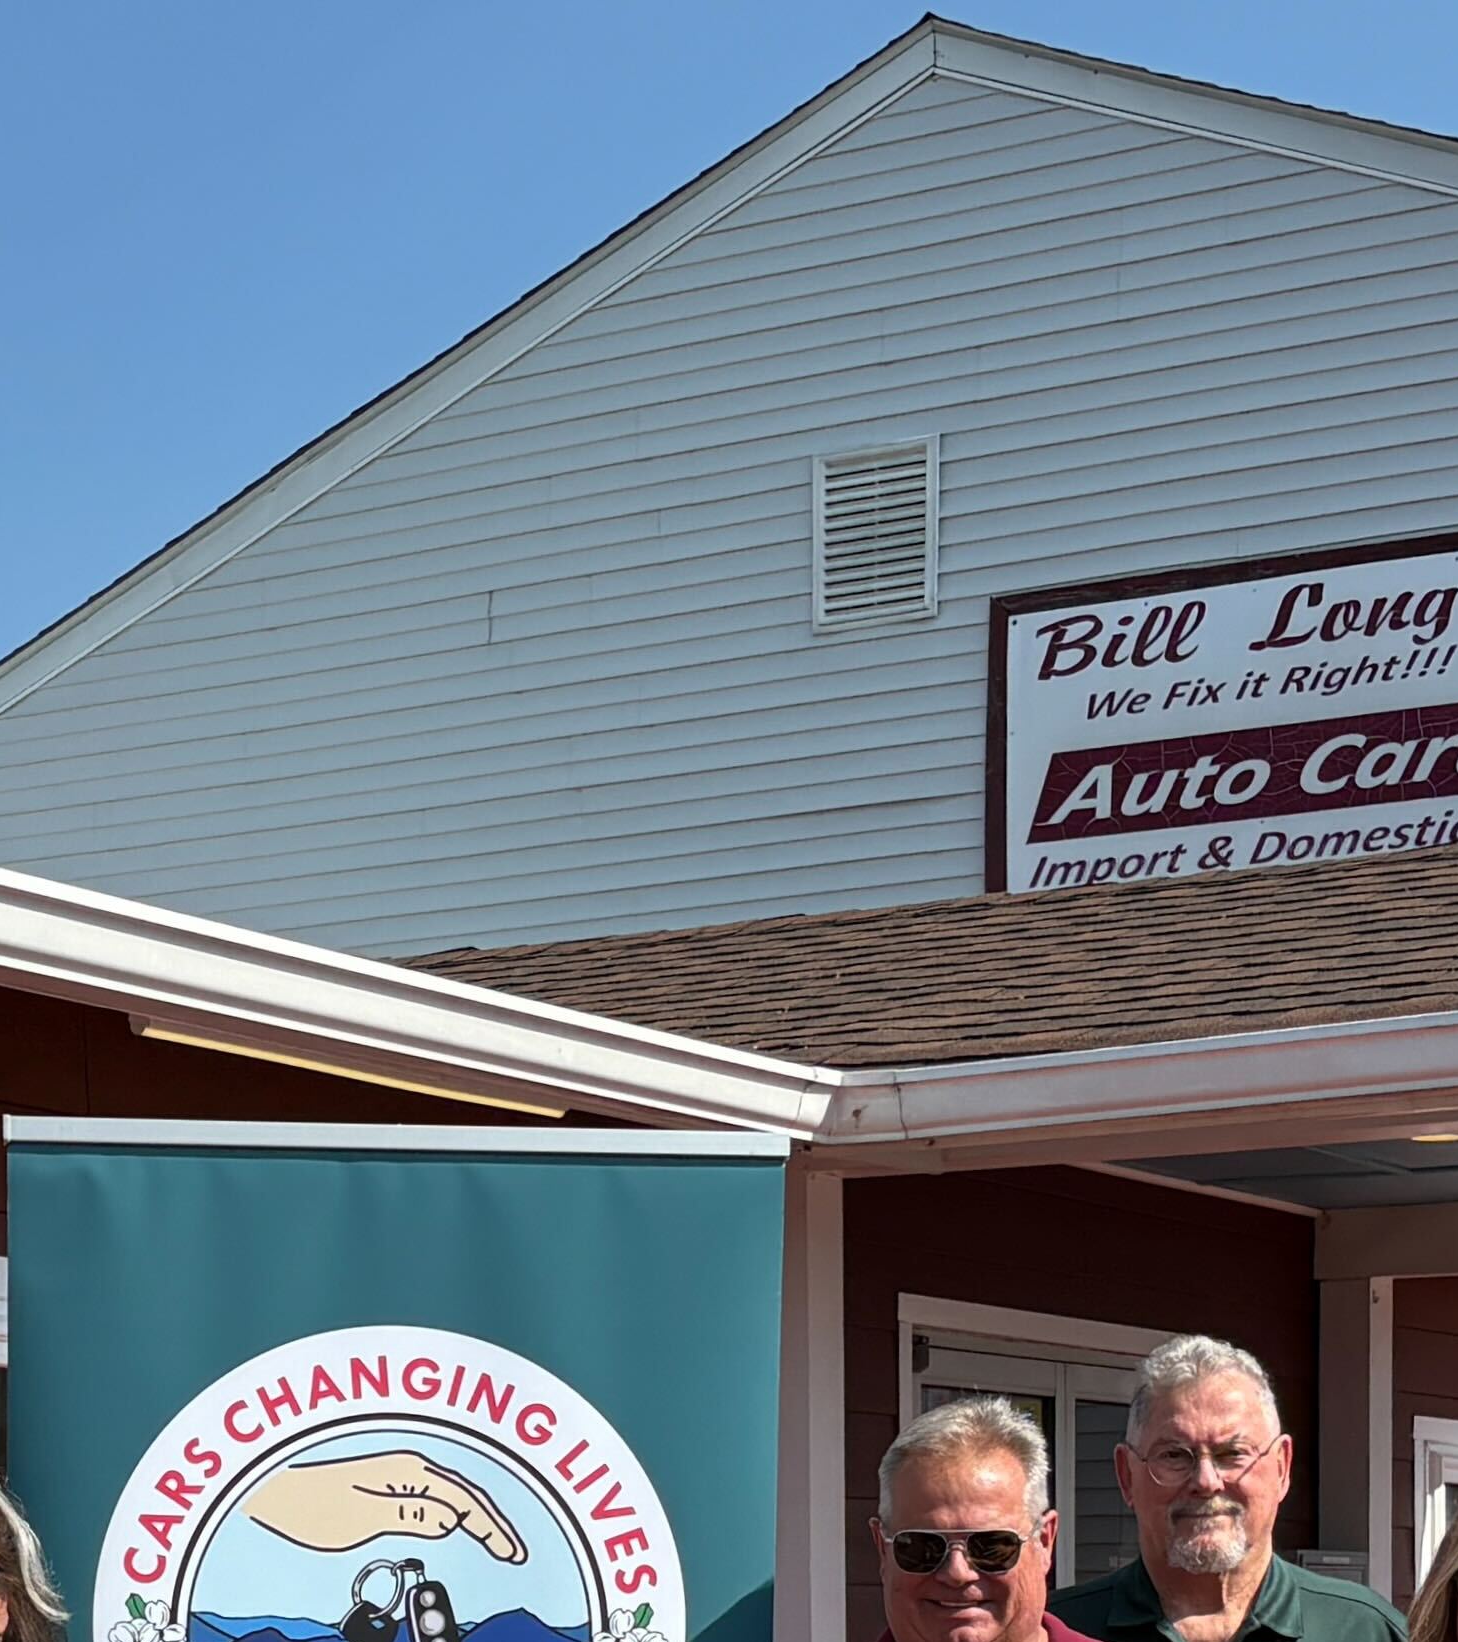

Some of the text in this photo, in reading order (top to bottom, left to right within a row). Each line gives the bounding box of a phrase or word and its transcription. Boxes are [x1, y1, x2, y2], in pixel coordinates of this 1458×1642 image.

[1035, 600, 1207, 681] Bill
[1086, 644, 1458, 720] We Fix it Right!!!
[1035, 755, 1272, 827] Auto
[1029, 842, 1187, 890] Import
[1197, 835, 1235, 869] &
[122, 1355, 658, 1595] CARS CHANGING LIVES
